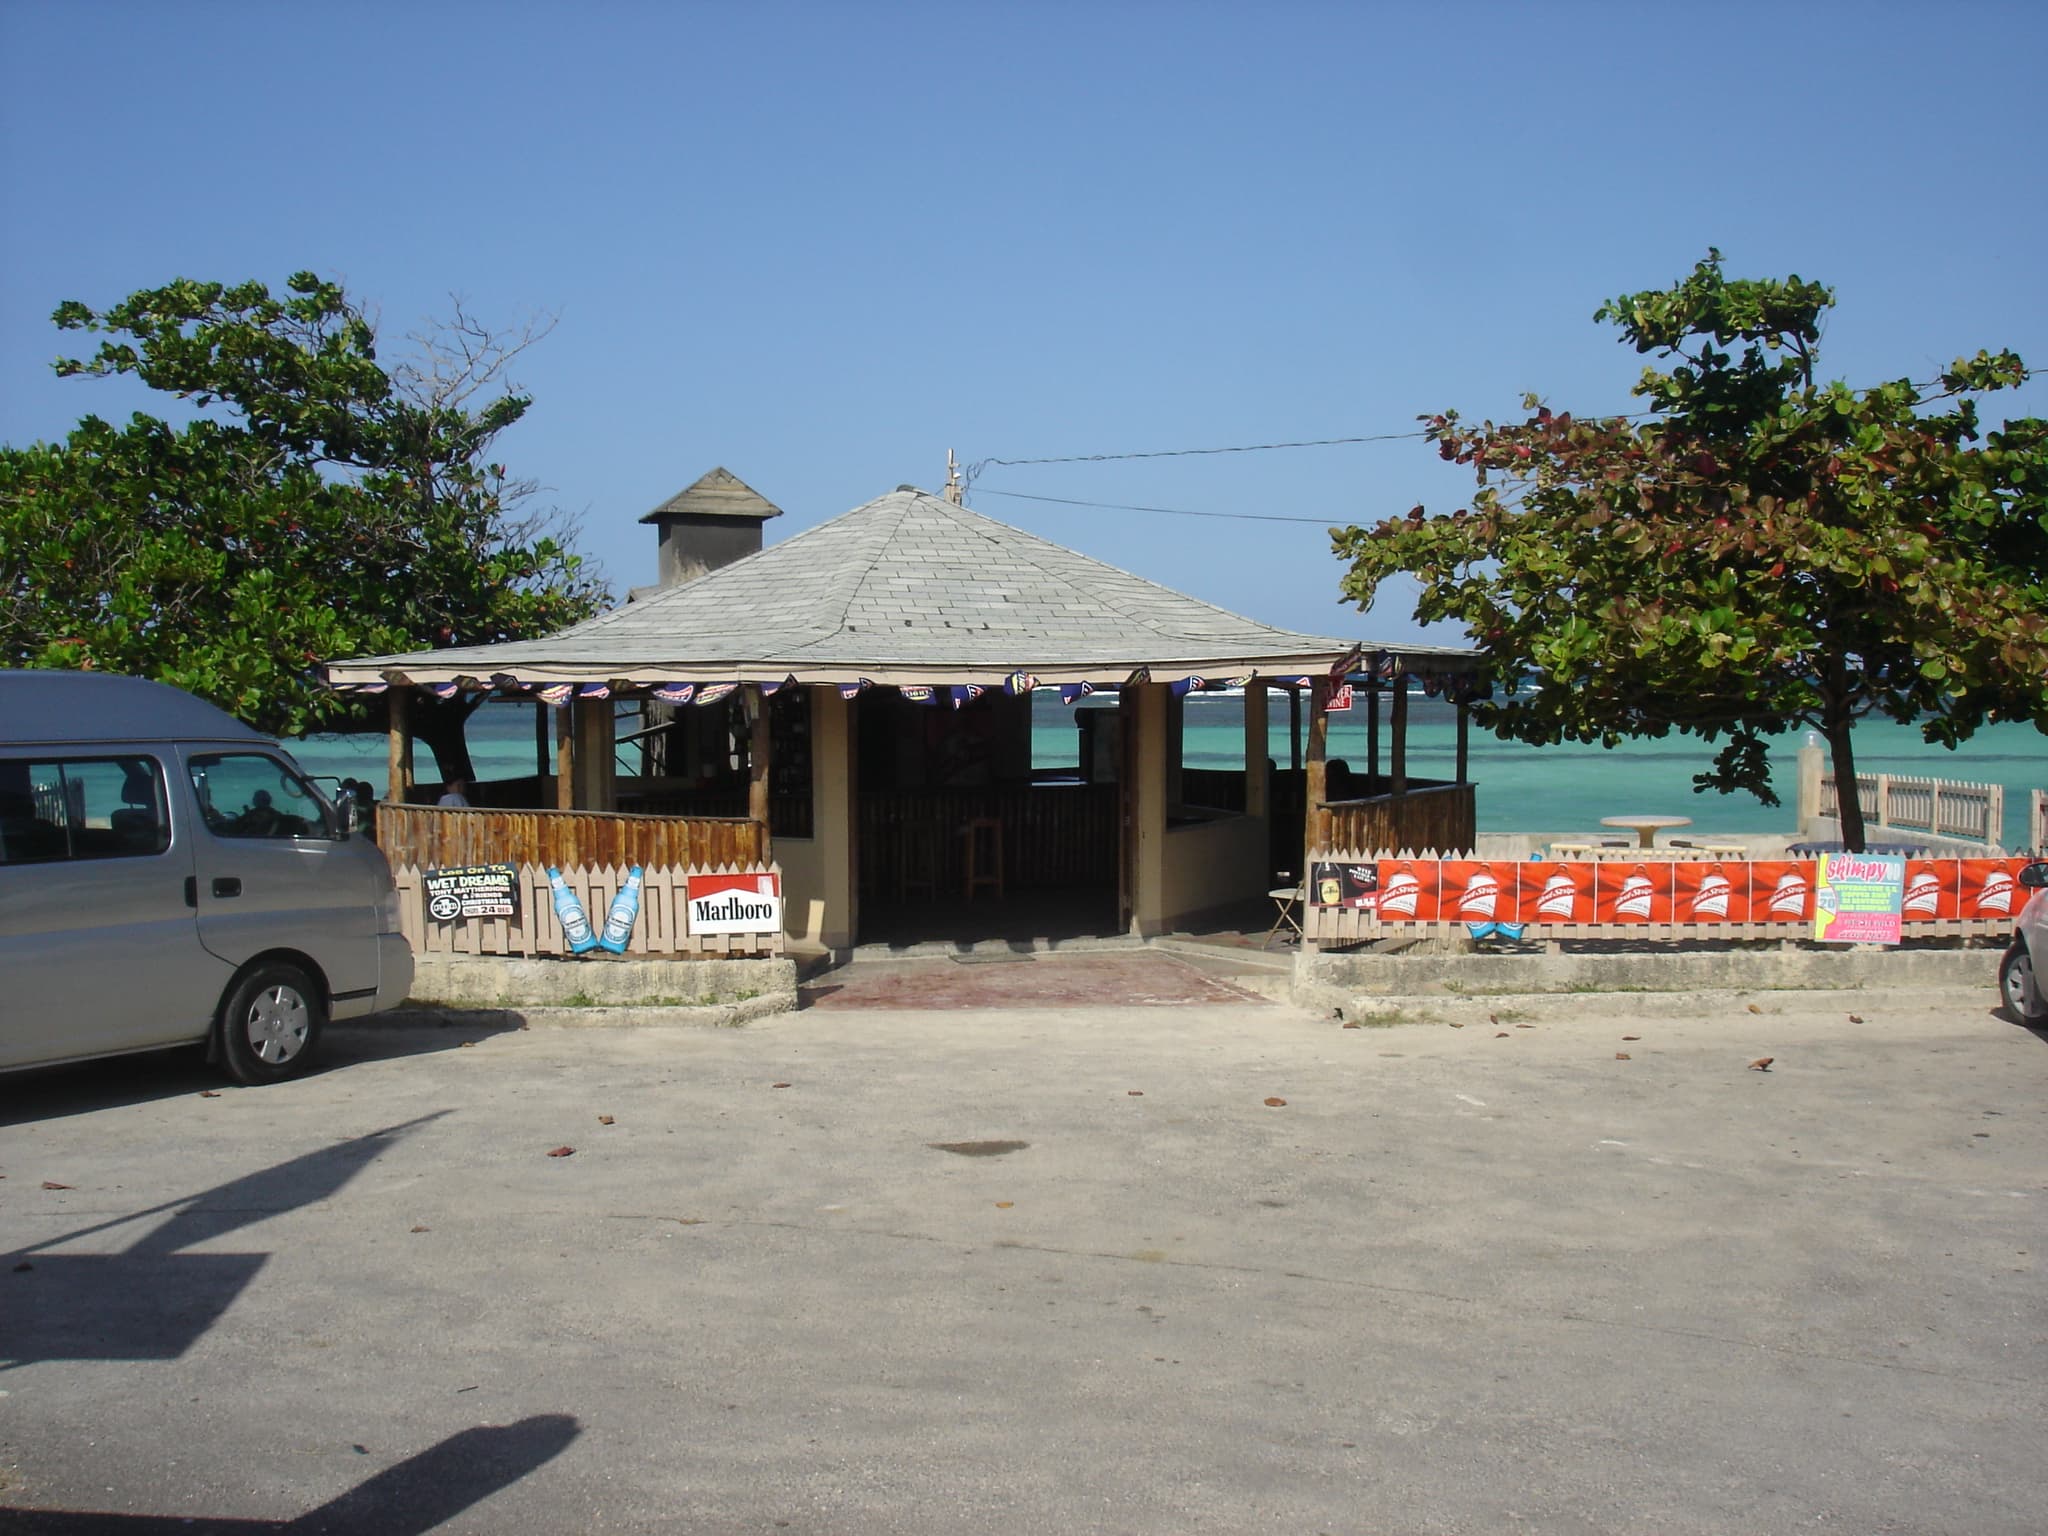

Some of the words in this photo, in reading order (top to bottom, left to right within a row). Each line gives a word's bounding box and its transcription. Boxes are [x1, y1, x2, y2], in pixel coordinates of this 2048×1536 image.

[427, 877, 457, 890] WET
[459, 875, 510, 887] DREAMS
[696, 897, 772, 921] Marlboro
